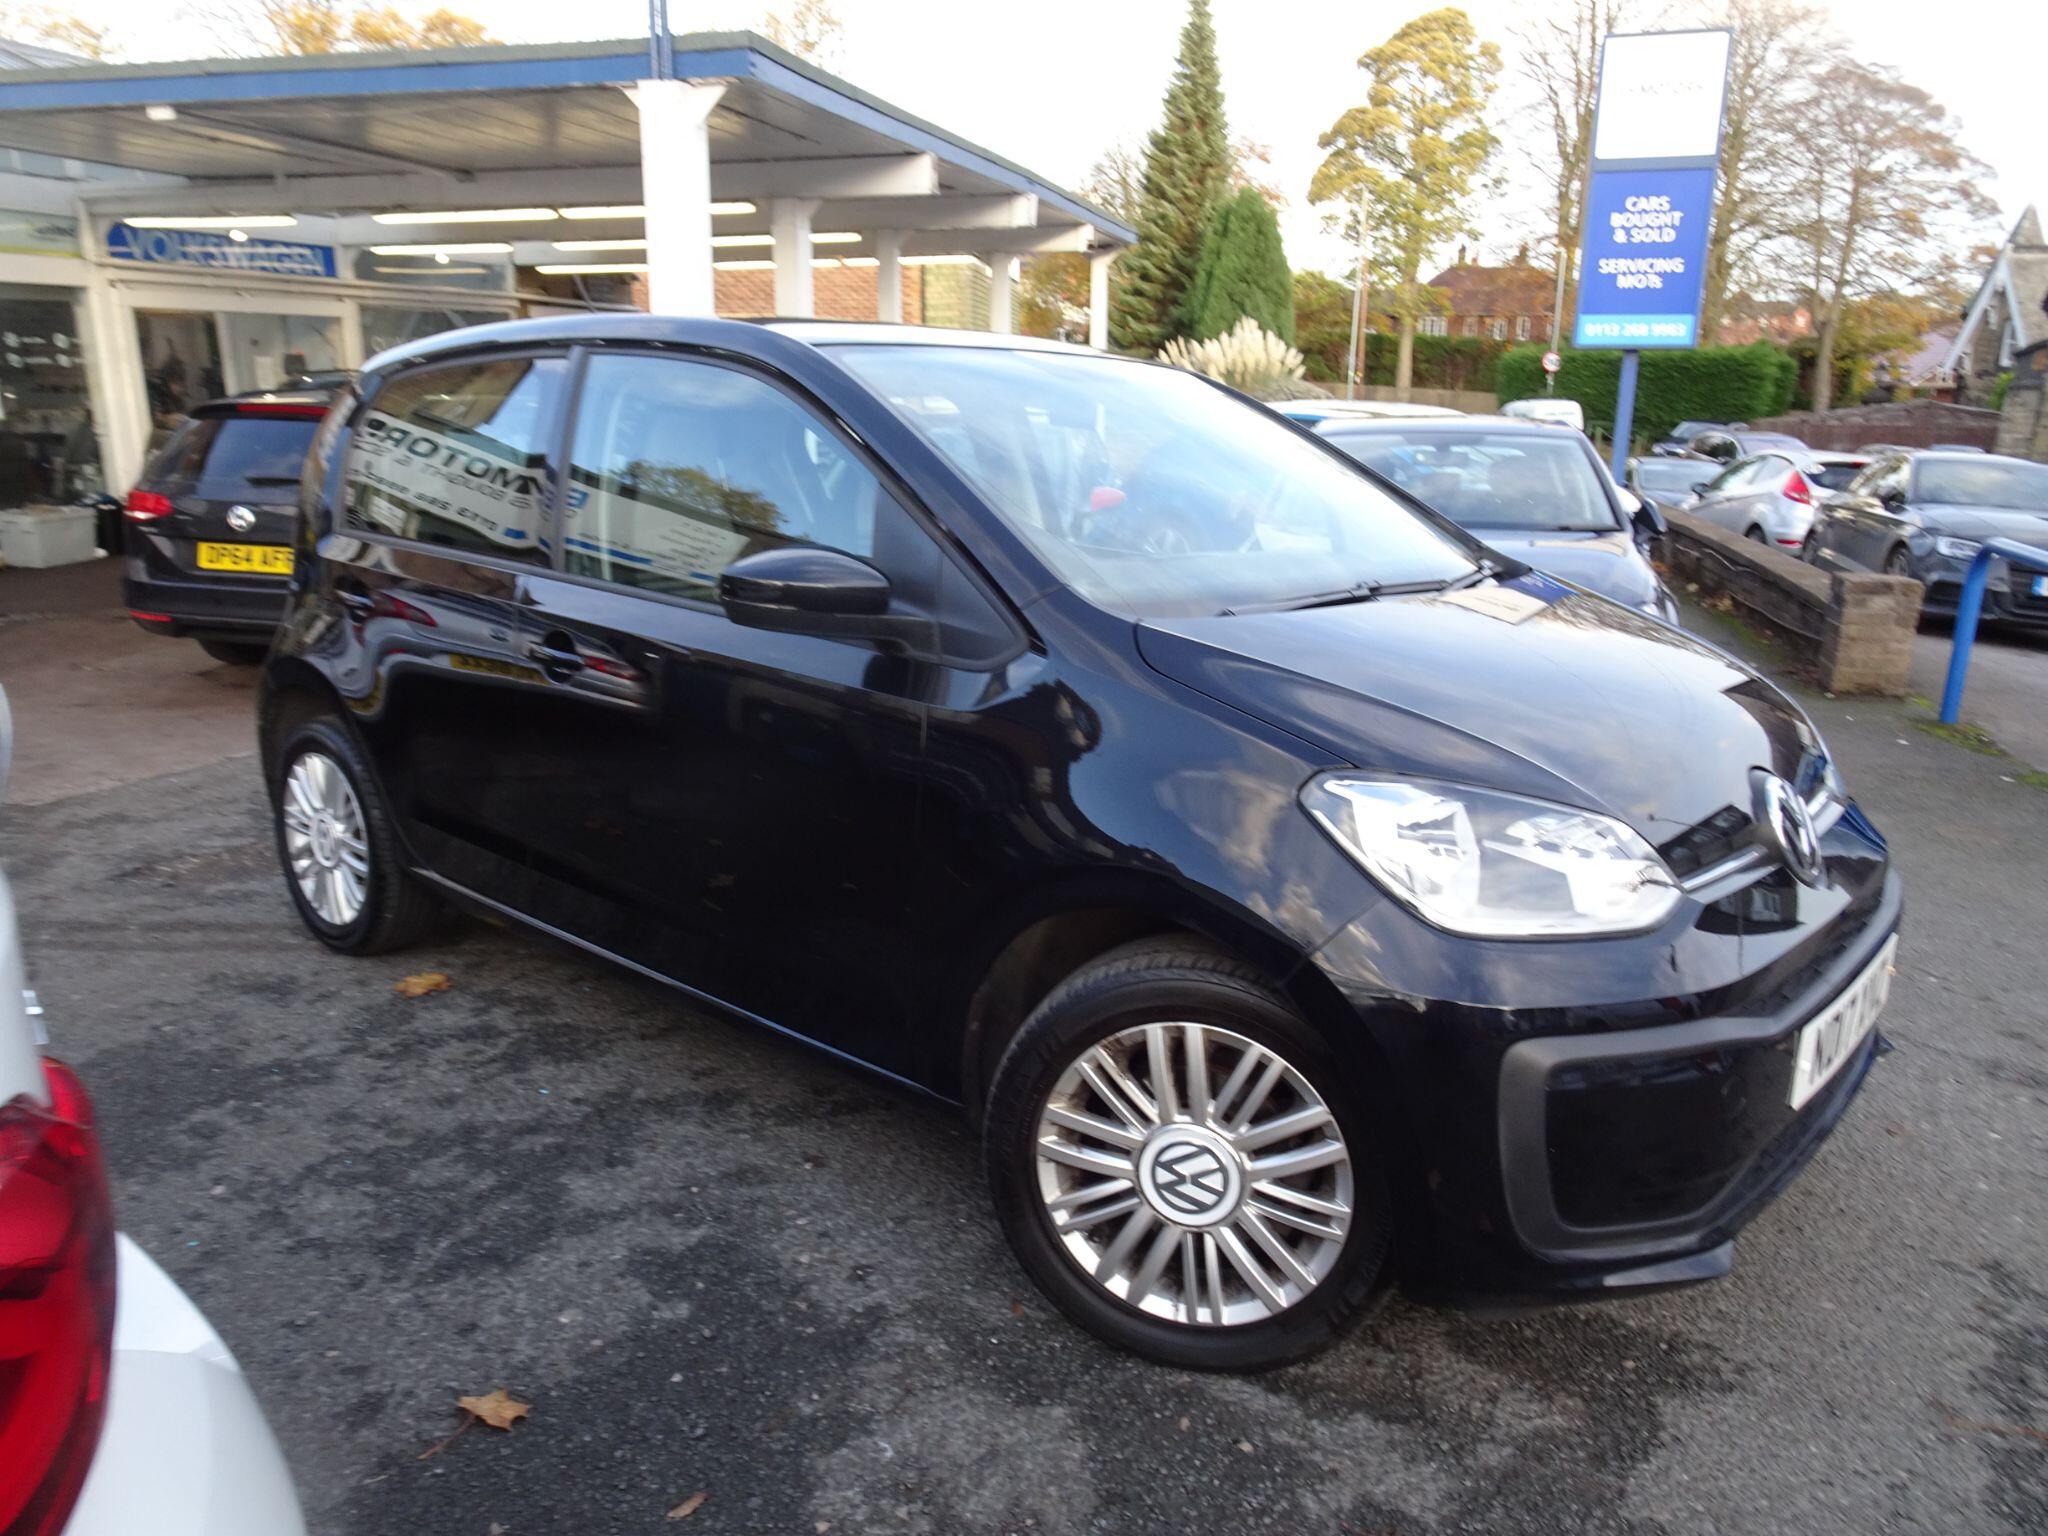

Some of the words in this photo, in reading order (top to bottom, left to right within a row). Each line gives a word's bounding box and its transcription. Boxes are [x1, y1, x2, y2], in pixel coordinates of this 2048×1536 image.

[1625, 195, 1671, 212] CARS
[1610, 211, 1684, 228] BOUGHT
[1613, 228, 1628, 243] &
[1630, 227, 1677, 243] SOLD
[1598, 257, 1685, 274] SERVICING
